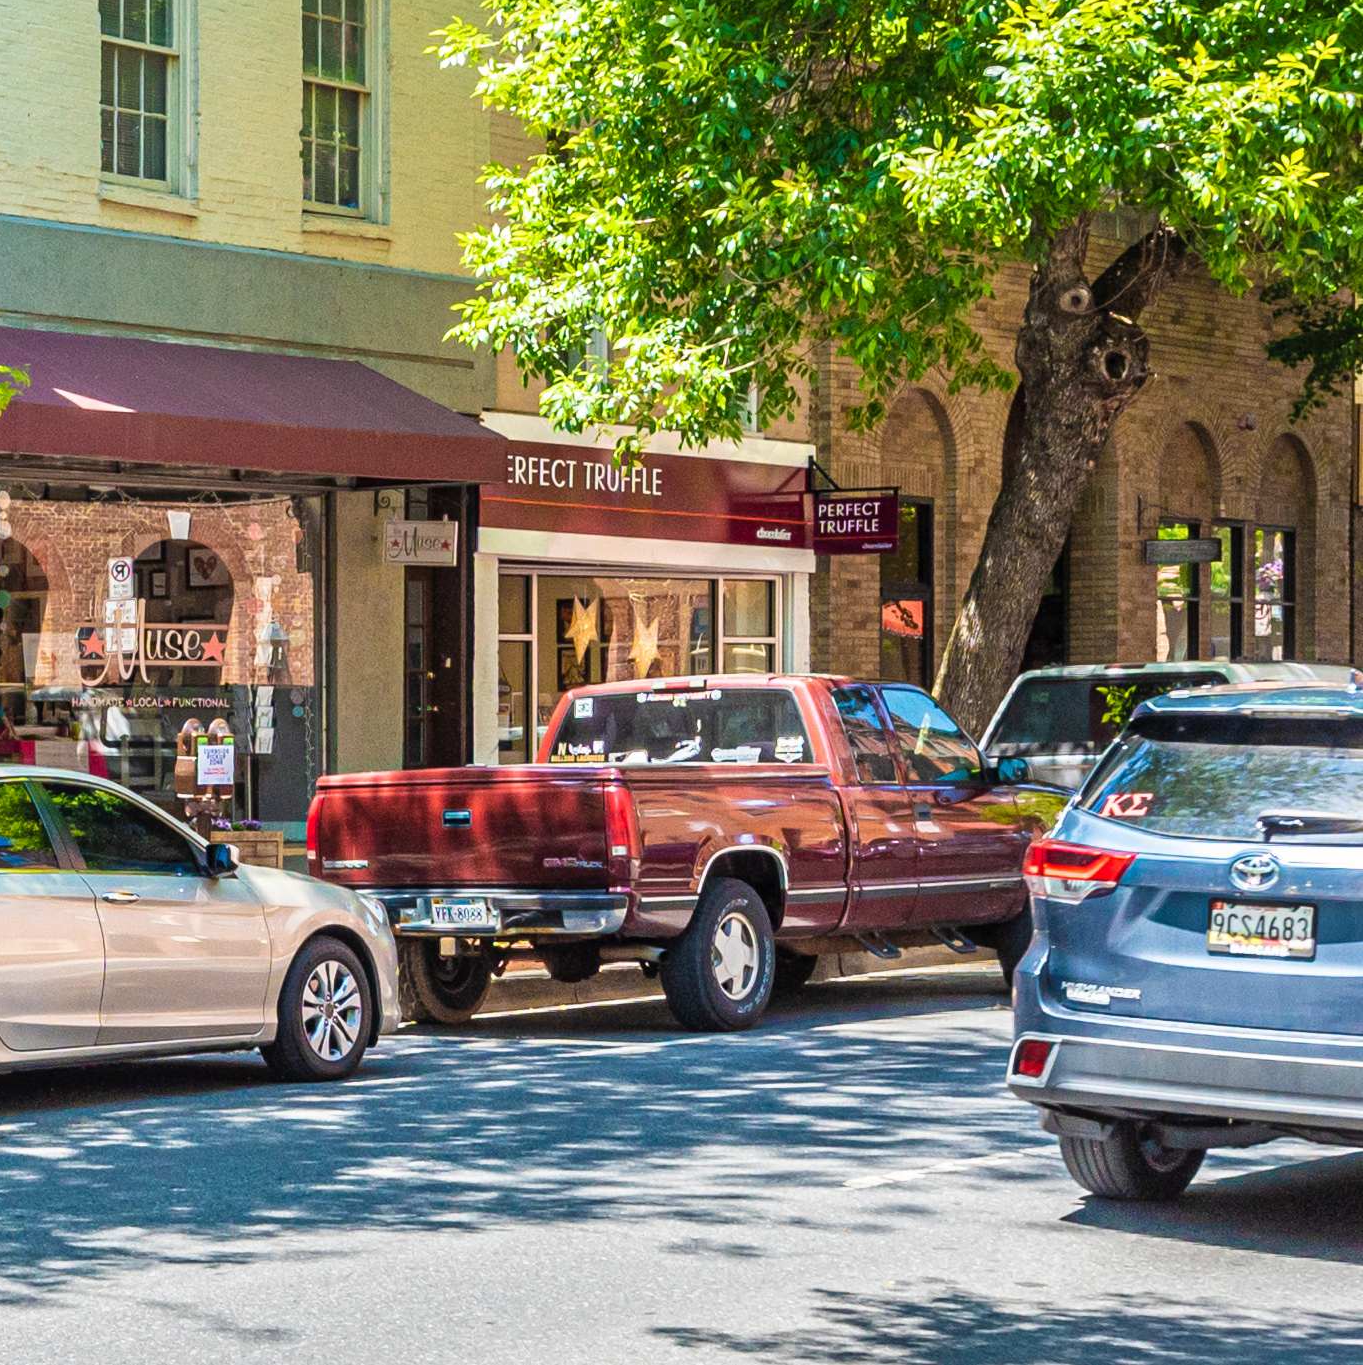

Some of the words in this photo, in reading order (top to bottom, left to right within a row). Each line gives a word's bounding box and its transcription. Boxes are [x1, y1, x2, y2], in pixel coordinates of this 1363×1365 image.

[507, 455, 576, 489] ERFECT
[583, 461, 663, 496] TRUFFLE
[818, 502, 881, 518] PERFECT
[819, 518, 880, 534] TRUFFLE
[389, 527, 442, 559] Muse
[71, 697, 125, 708] HANDMADE
[133, 697, 164, 708] LOCAL
[172, 697, 230, 708] FUNCTIONAL
[1213, 913, 1309, 941] 9CS4683
